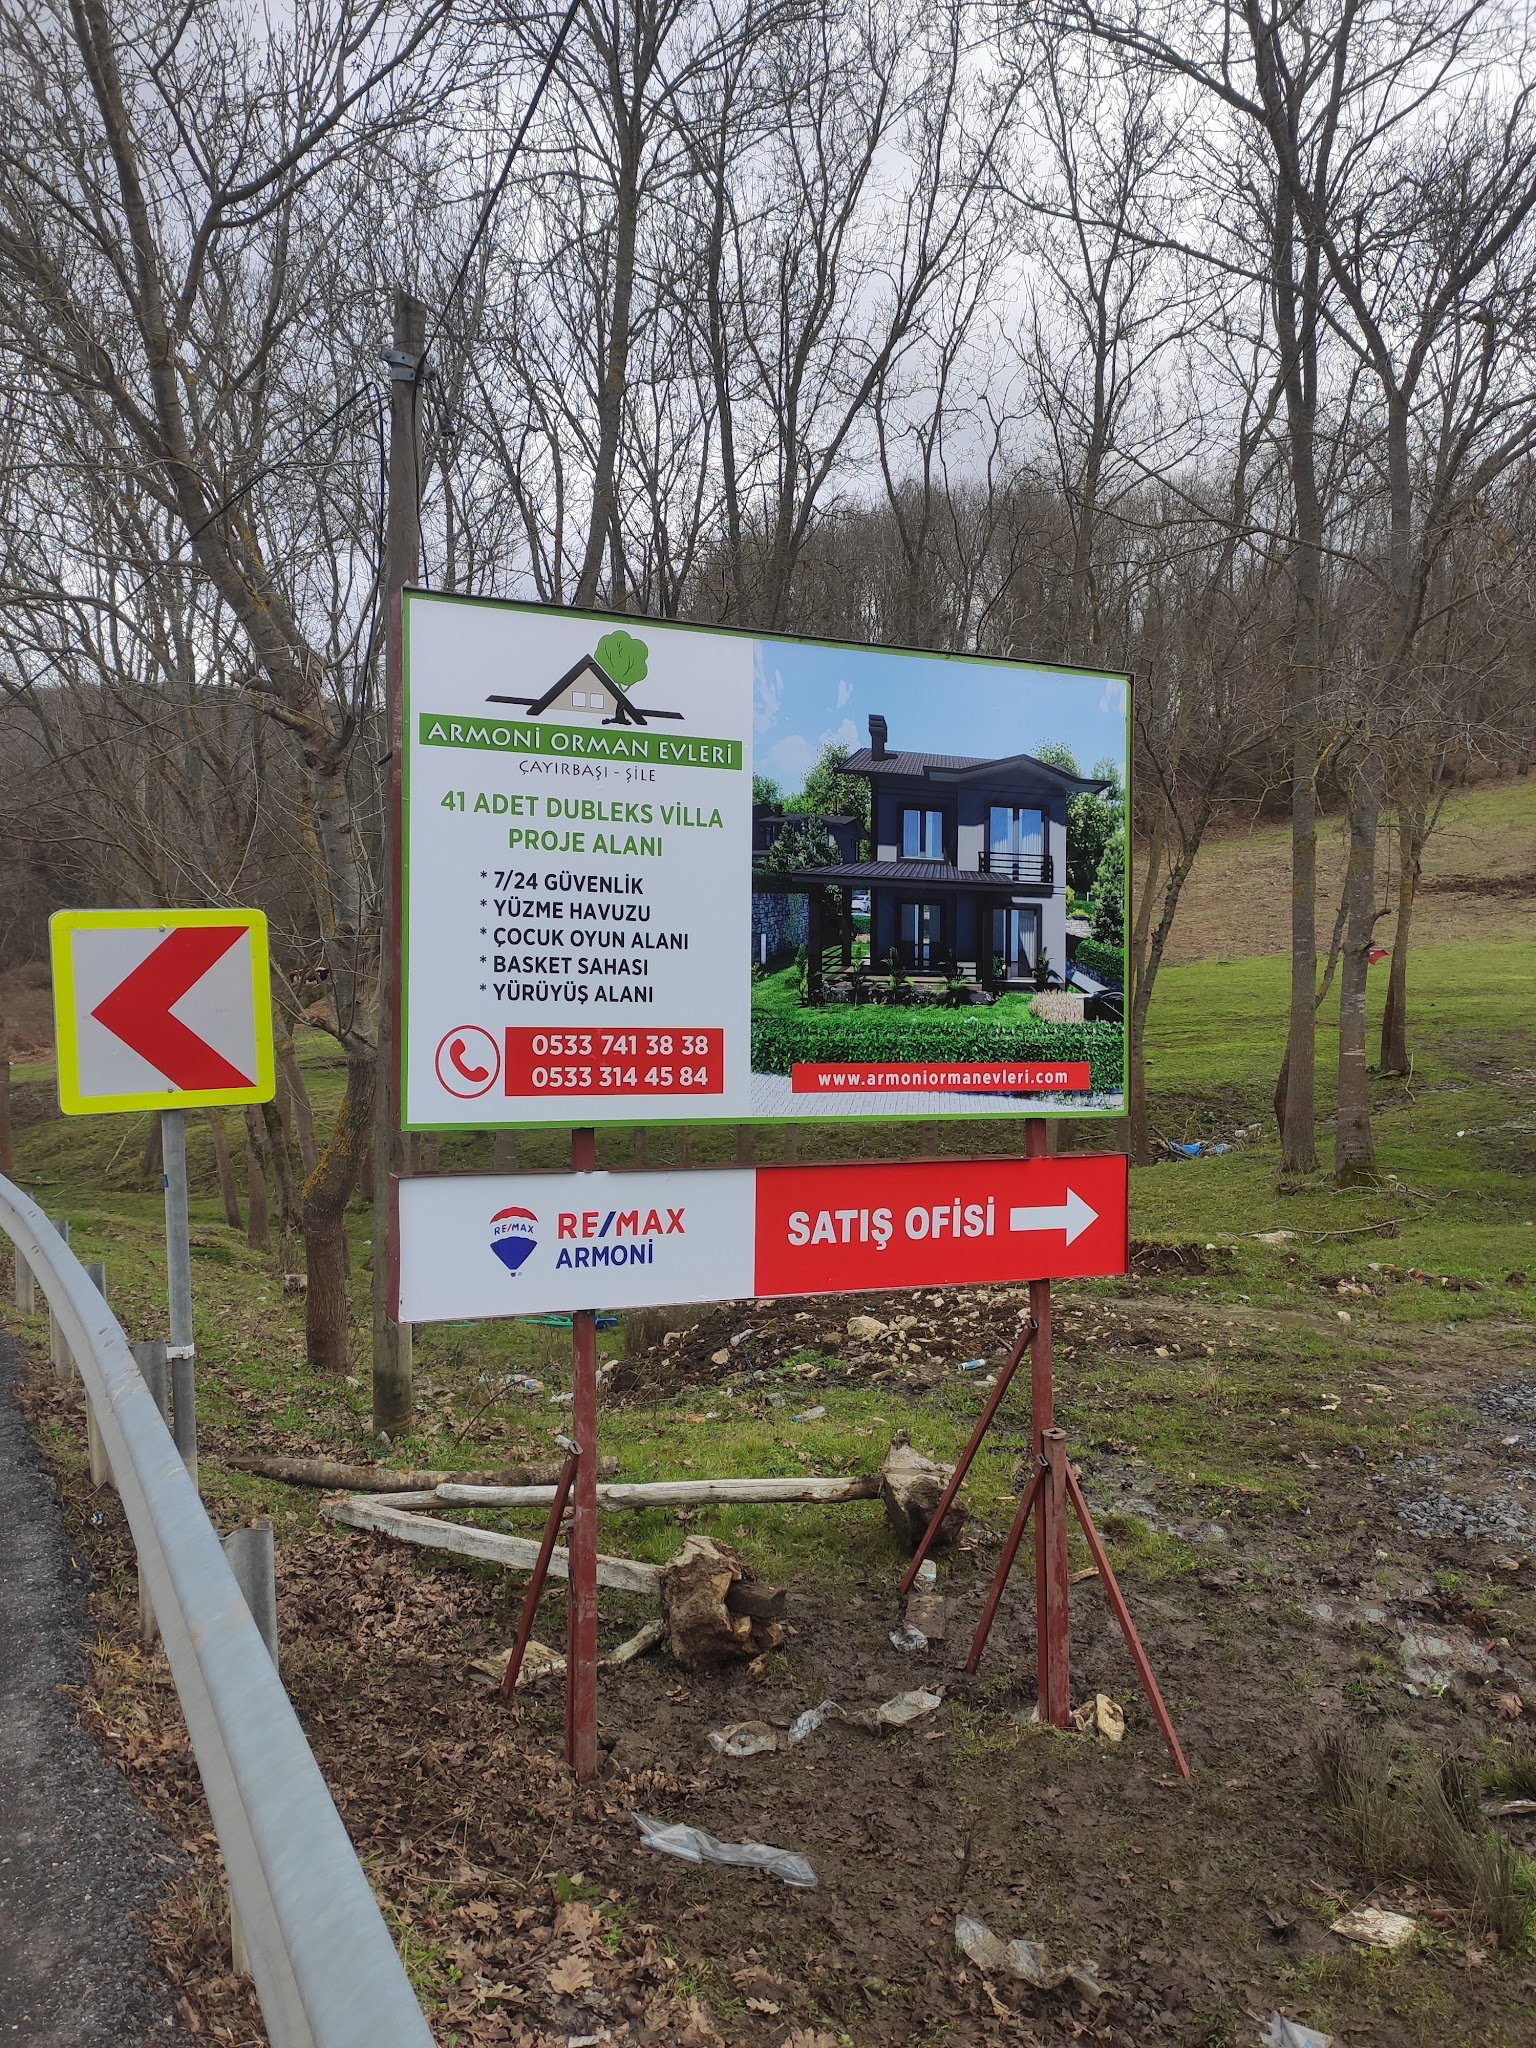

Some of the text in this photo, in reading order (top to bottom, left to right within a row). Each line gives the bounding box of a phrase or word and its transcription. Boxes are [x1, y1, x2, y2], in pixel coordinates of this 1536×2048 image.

[427, 721, 733, 764] ARMONİ ORMAN EVLERİ
[519, 760, 608, 780] ÇAYIRBAŞI
[626, 766, 656, 783] ŞİLE
[440, 790, 724, 828] 41 ADET DUBLEKS VİLLA
[508, 828, 663, 857] PROJE ALANI
[493, 869, 644, 895] 7/24 GÜVENLİK
[493, 896, 650, 922] YÜZME HAVUZU
[493, 927, 689, 950] ÇOCUK OYUN ALANI
[493, 955, 648, 976] BASKET SAHASI
[493, 979, 653, 1006] YÜRÜYÜŞ ALANI
[531, 1034, 709, 1056] 0533 741 38 38
[531, 1066, 709, 1088] 0533 314 45 84
[817, 1068, 1068, 1087] www.armoniormanevleri.com
[494, 1223, 534, 1236] RE/MAX
[557, 1208, 686, 1240] RE/MAX
[787, 1196, 995, 1251] SATIŞ OFİSİ
[555, 1239, 653, 1269] ARMONİ
